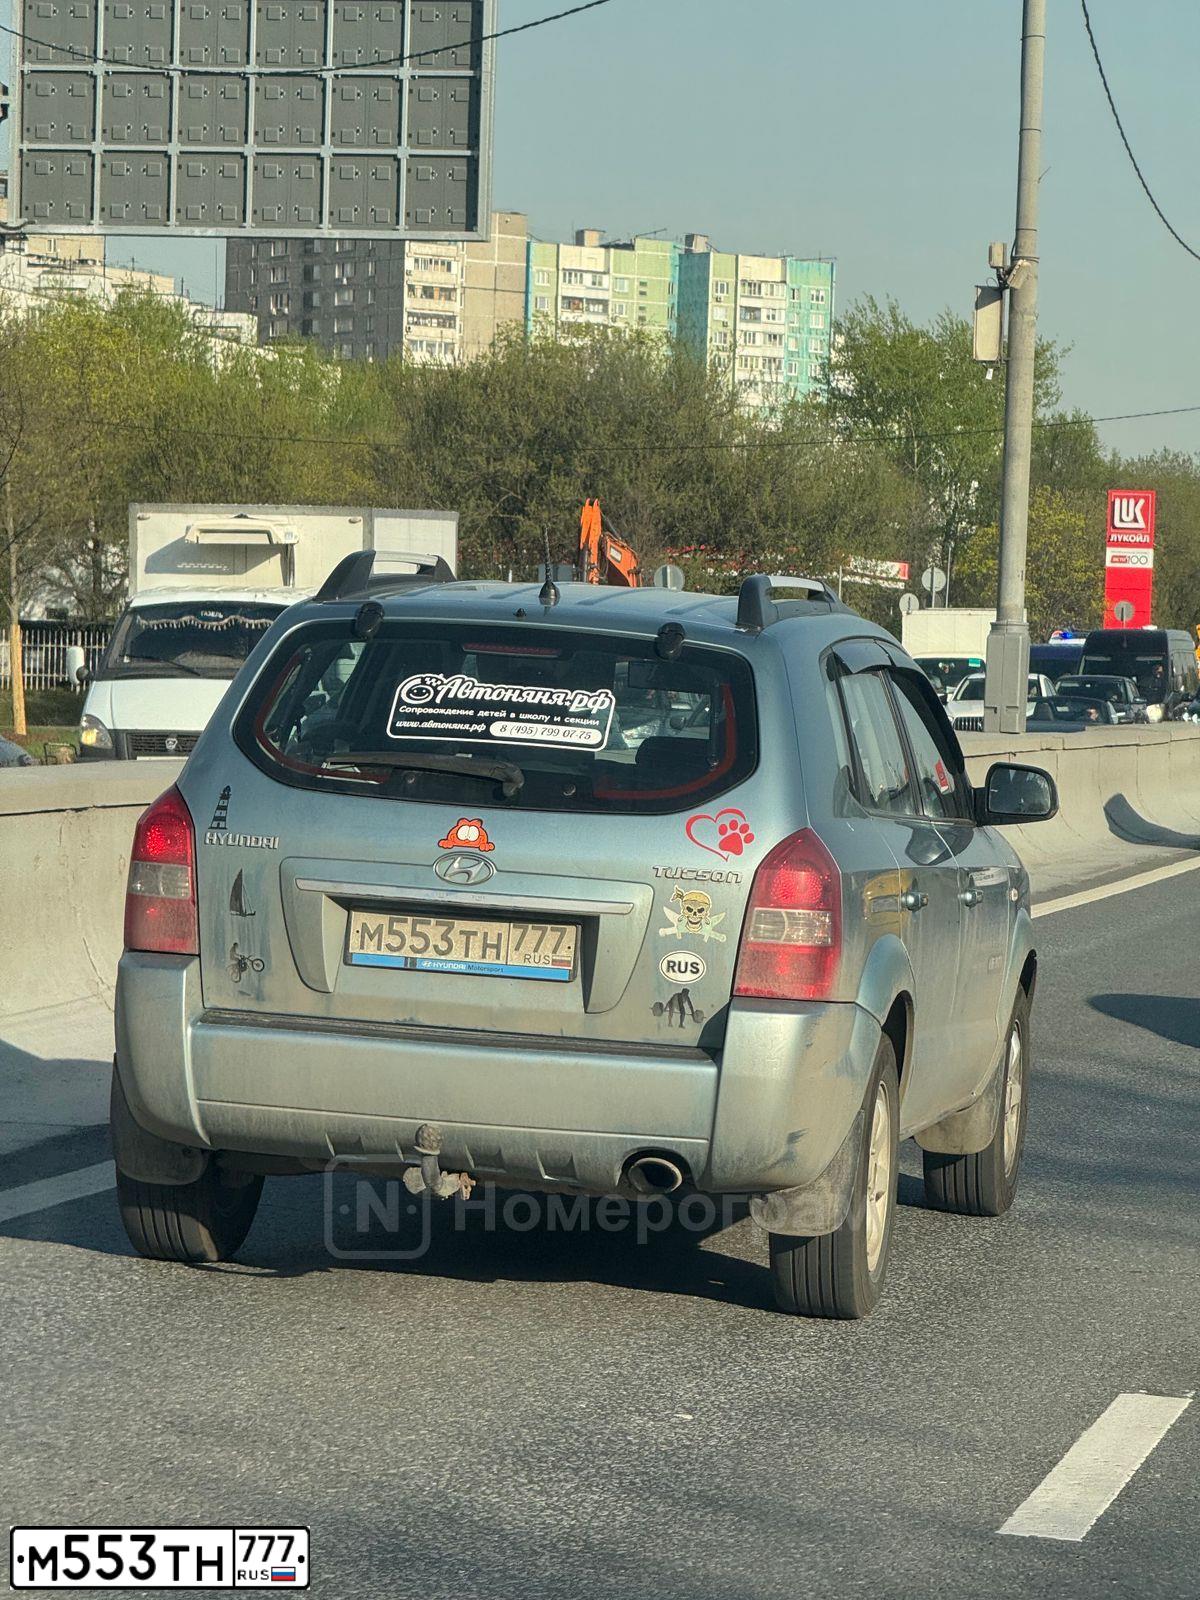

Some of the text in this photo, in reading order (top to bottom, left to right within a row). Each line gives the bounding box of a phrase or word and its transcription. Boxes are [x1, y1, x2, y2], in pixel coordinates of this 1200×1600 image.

[1110, 533, 1150, 543] ЛУКОЙЛ
[399, 705, 475, 716] Сопровождение
[477, 709, 507, 718] детей
[519, 712, 550, 723] школу
[564, 716, 600, 726] секции
[395, 719, 487, 733] www.автоняня.рф
[499, 724, 593, 740] 8 (495) 799 07-75
[204, 831, 279, 849] HYUNDAI
[652, 865, 743, 884] TUCSON
[359, 917, 503, 960] М553ТН
[511, 923, 568, 954] 777
[433, 962, 466, 970] HYUNDAI
[523, 953, 550, 965] RUS
[665, 960, 700, 975] RUS
